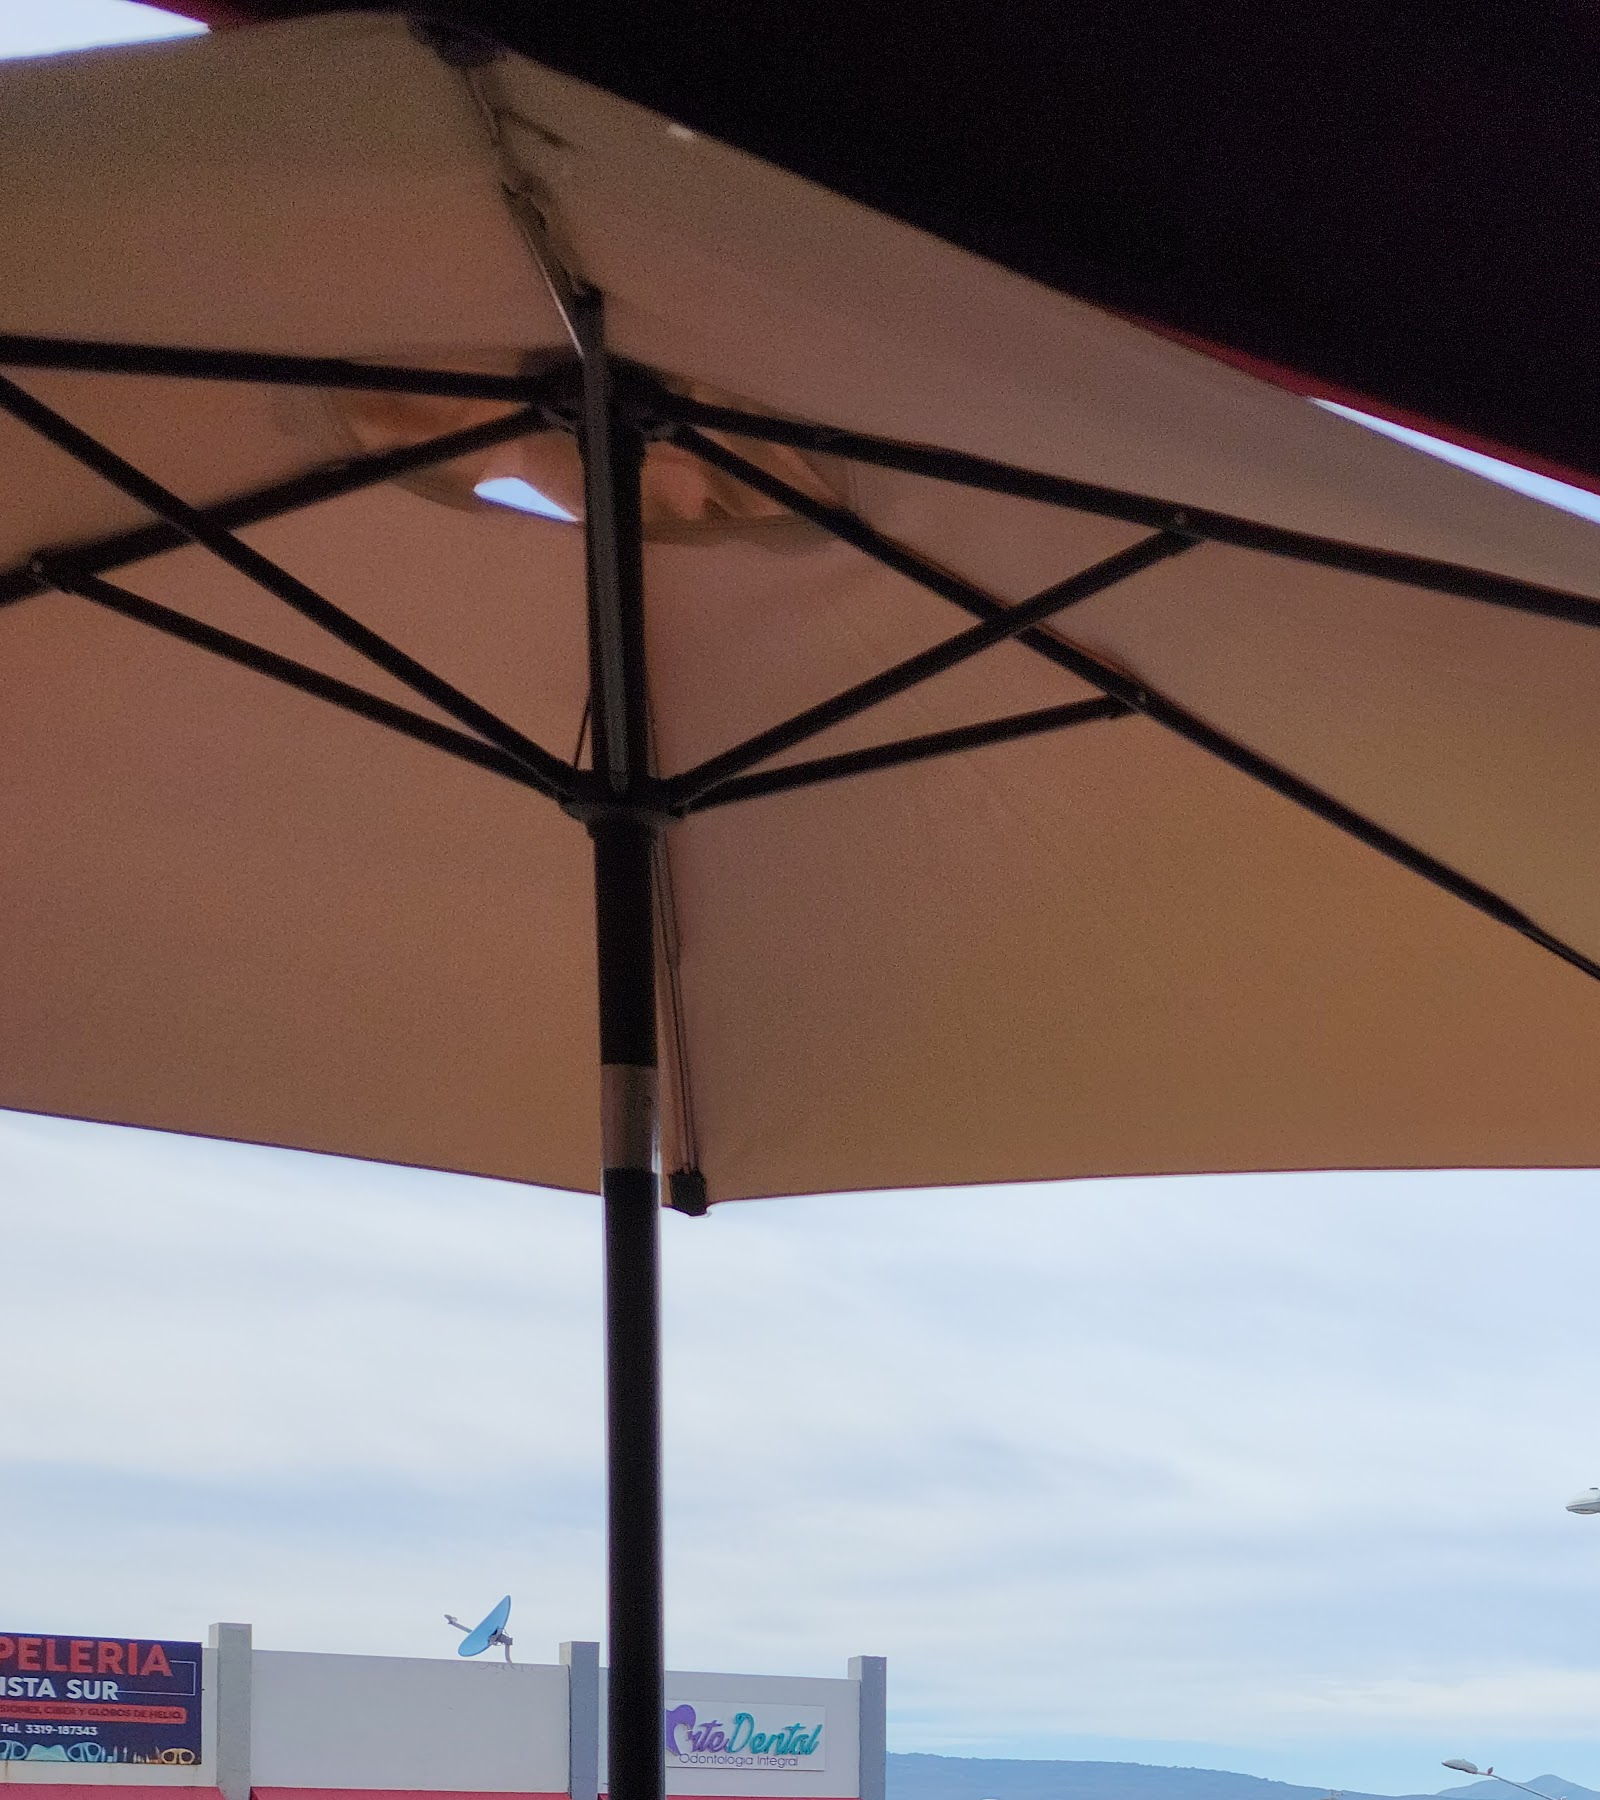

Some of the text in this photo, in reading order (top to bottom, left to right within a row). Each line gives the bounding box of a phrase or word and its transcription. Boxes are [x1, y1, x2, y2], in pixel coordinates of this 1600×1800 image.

[66, 1679, 119, 1701] SUR
[88, 1708, 131, 1718] GLOBOS
[134, 1709, 148, 1718] DE
[2, 1723, 98, 1736] Tel. 3319-187343
[757, 1755, 798, 1768] Integral
